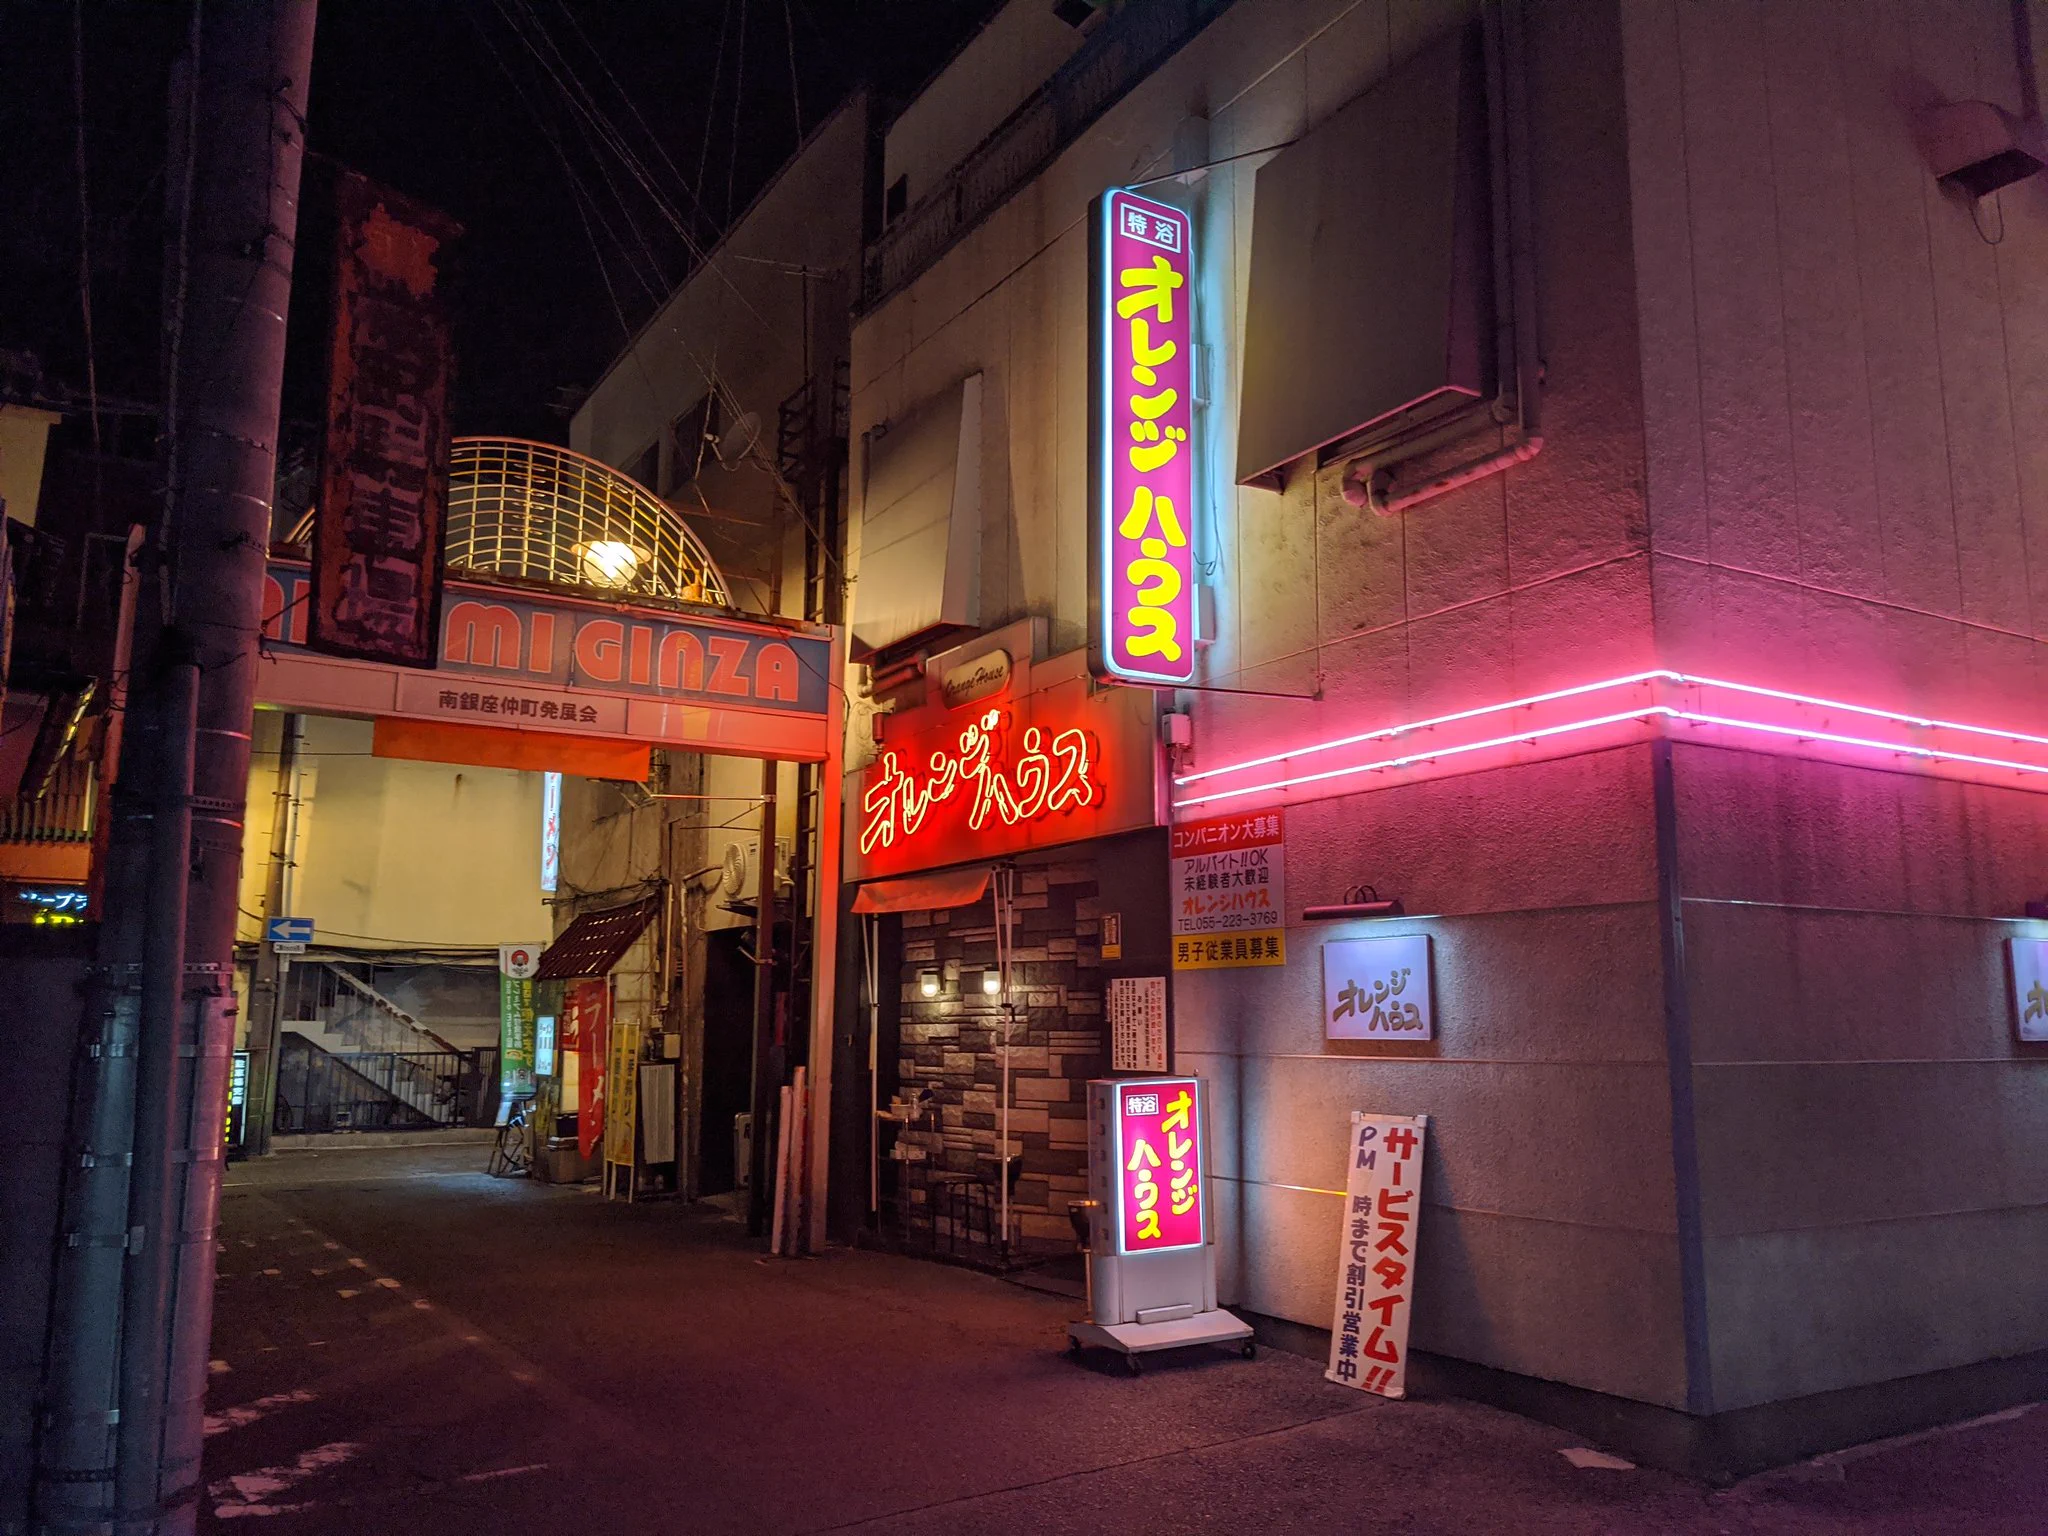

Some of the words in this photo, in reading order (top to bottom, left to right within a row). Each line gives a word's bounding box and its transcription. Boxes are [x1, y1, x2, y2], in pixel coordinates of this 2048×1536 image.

[1128, 212, 1174, 244] 特浴
[1116, 254, 1187, 661] オレンジハウス
[573, 619, 800, 703] GINZA
[975, 665, 1005, 686] House
[438, 690, 598, 723] 南銀座仲町発展会
[1182, 888, 1271, 916] オレンジハウス
[1177, 936, 1279, 963] 男子従業員募集
[1333, 967, 1411, 1022] オレンジ
[1368, 1000, 1423, 1032] ハウス
[2024, 979, 2048, 1023] オ
[1128, 1096, 1156, 1113] 特浴
[1161, 1090, 1198, 1215] オレンジ
[1356, 1125, 1378, 1171] PM
[1127, 1139, 1162, 1240] ハウス
[1336, 1194, 1373, 1383] 時まで割引営業中
